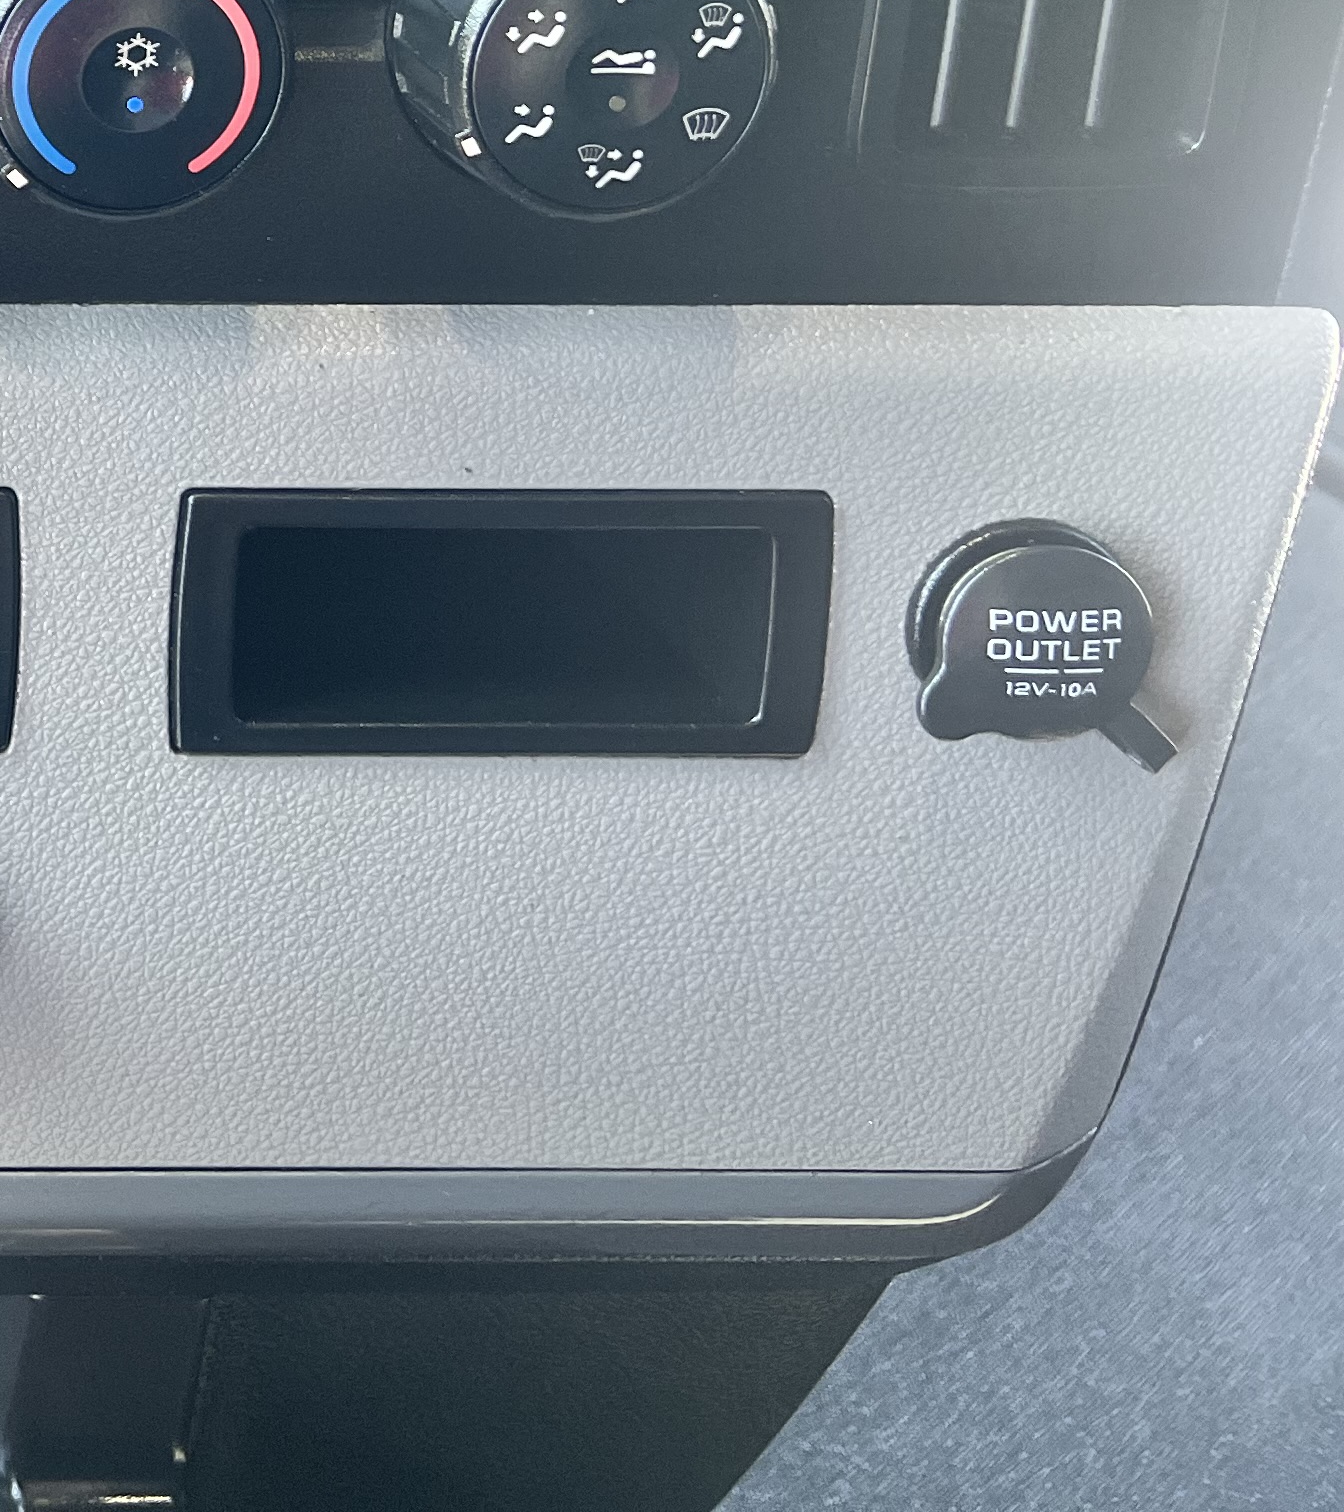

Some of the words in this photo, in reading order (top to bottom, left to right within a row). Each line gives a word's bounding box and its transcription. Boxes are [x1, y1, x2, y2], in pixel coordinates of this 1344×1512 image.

[988, 608, 1122, 633] POWER
[986, 638, 1122, 661] OUTLET
[1005, 681, 1097, 698] 12V-10A
